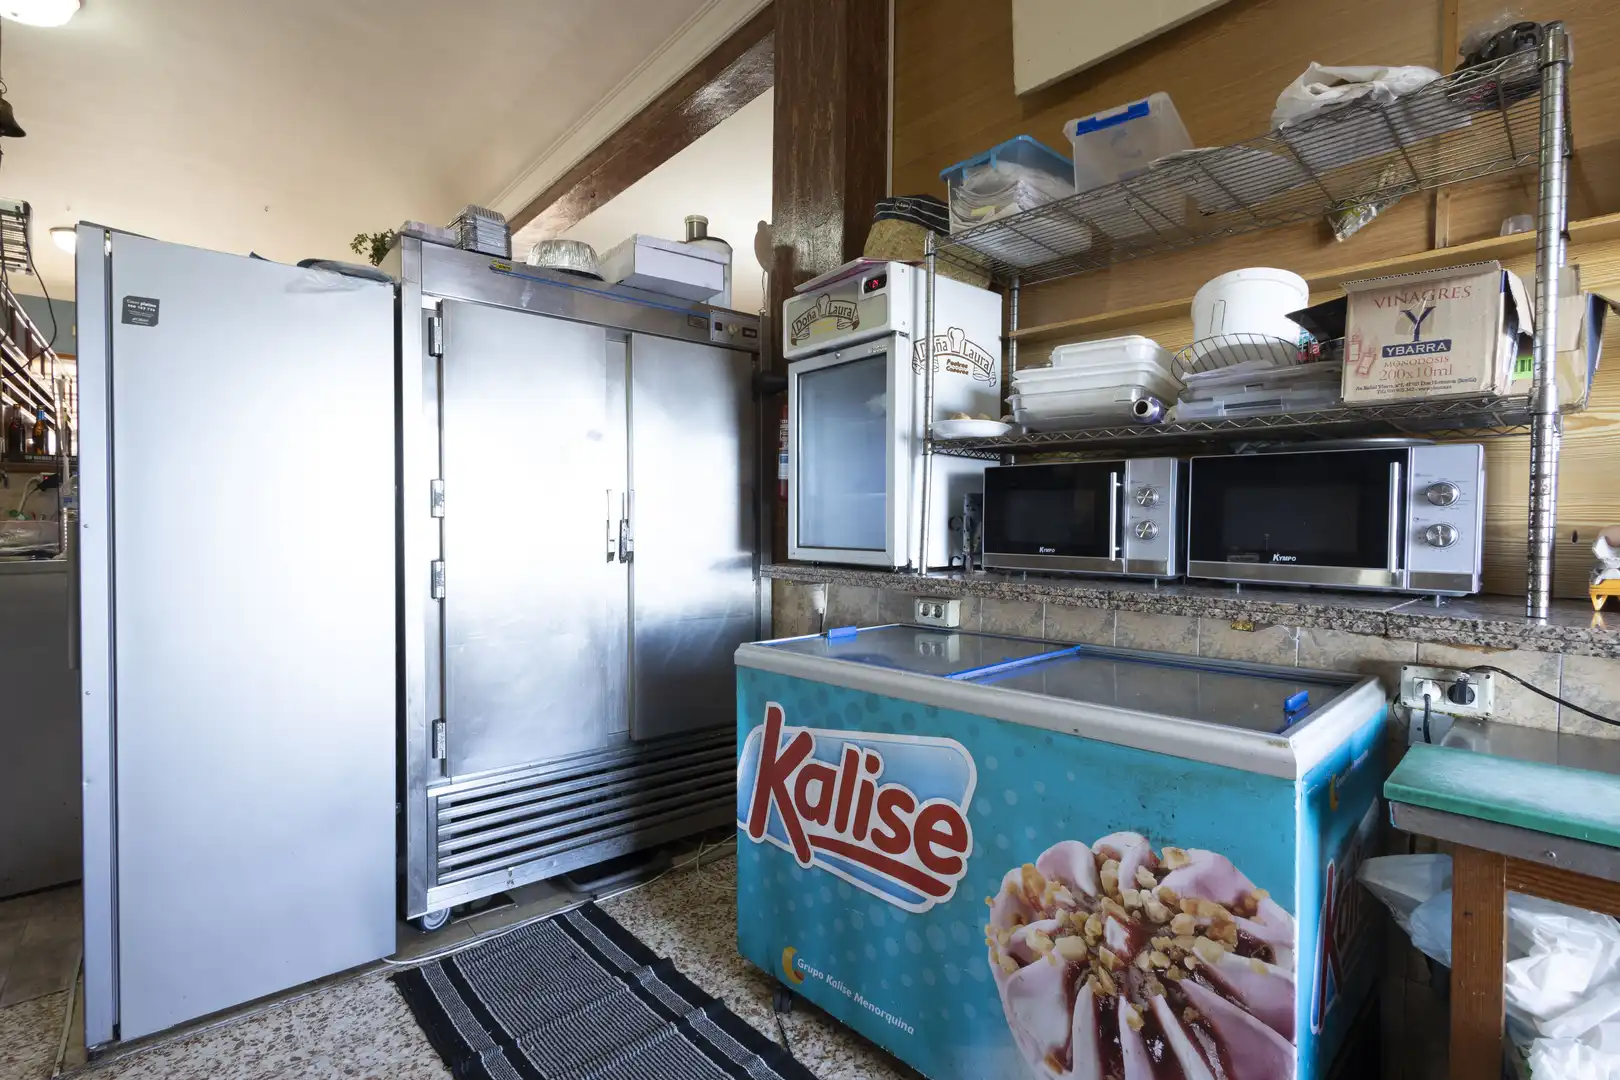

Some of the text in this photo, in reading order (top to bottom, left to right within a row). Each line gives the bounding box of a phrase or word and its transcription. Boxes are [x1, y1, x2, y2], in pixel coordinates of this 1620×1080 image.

[1373, 285, 1473, 309] VINAGRES
[795, 310, 817, 331] Doña
[828, 302, 853, 318] Laura
[963, 341, 991, 372] Laura
[1384, 356, 1450, 368] MONODOSIS
[1386, 342, 1448, 356] YBARRA
[1379, 363, 1453, 381] 200x10ml
[748, 705, 969, 876] Kalise
[797, 958, 915, 1036] Grupo Kalise Menorquina
